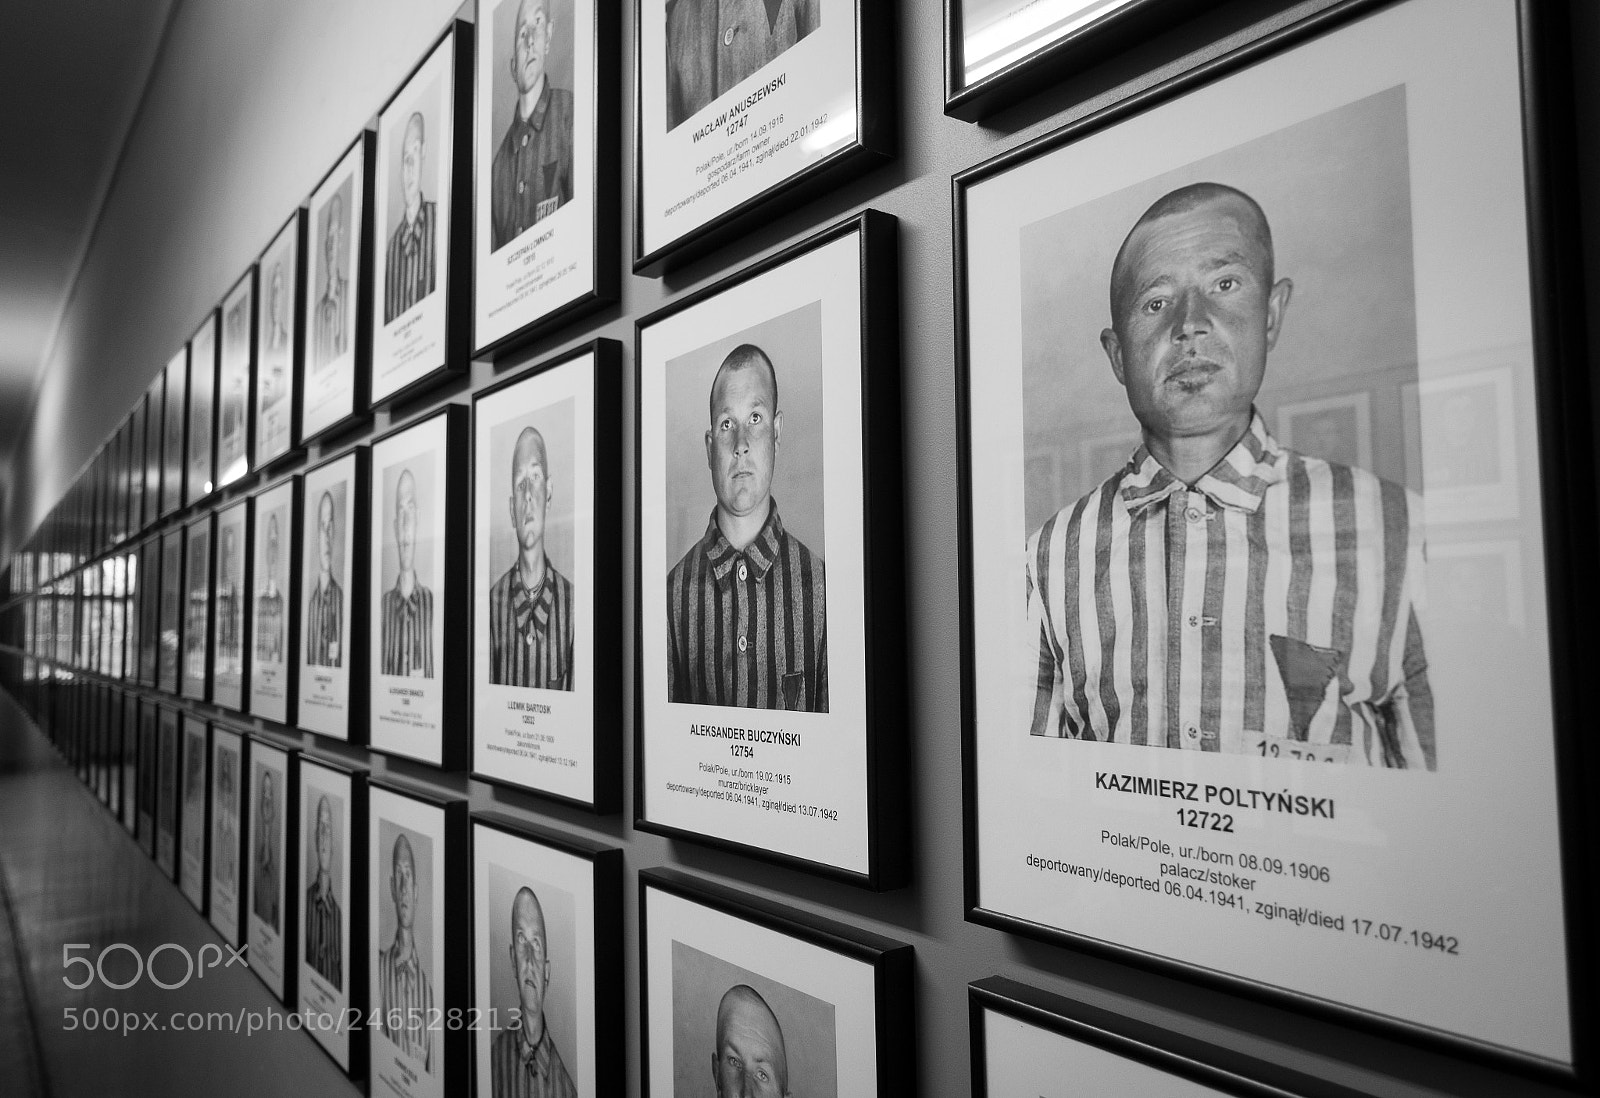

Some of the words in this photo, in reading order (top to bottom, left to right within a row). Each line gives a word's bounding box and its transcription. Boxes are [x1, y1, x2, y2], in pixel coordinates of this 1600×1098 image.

[692, 112, 728, 144] WACŁAW
[729, 73, 787, 120] ANUSZEWSKI
[725, 114, 749, 138] 12747
[751, 136, 771, 154] owner
[690, 723, 746, 741] ALEKSANDER
[747, 728, 801, 747] BUCZYŃSKI
[730, 744, 754, 759] 12754
[718, 779, 769, 796] murarz/bricklayer
[755, 770, 792, 785] 19.02.1915
[1095, 771, 1199, 802] KAZIMIERZ
[1204, 785, 1335, 819] POLTYŃSKI
[798, 803, 838, 821] 13.07.1942
[1175, 807, 1235, 833] 12722
[1100, 829, 1175, 858] Polak/Pole,
[1179, 845, 1234, 867] ur./born
[1238, 852, 1331, 883] 08.09.1906
[1159, 859, 1257, 892] palacz/stoker
[1025, 853, 1160, 893] deportowany/deported
[1164, 881, 1251, 914] 06.04.1941,
[1254, 900, 1345, 931] zginął/died
[1350, 917, 1460, 956] 17.07.1942
